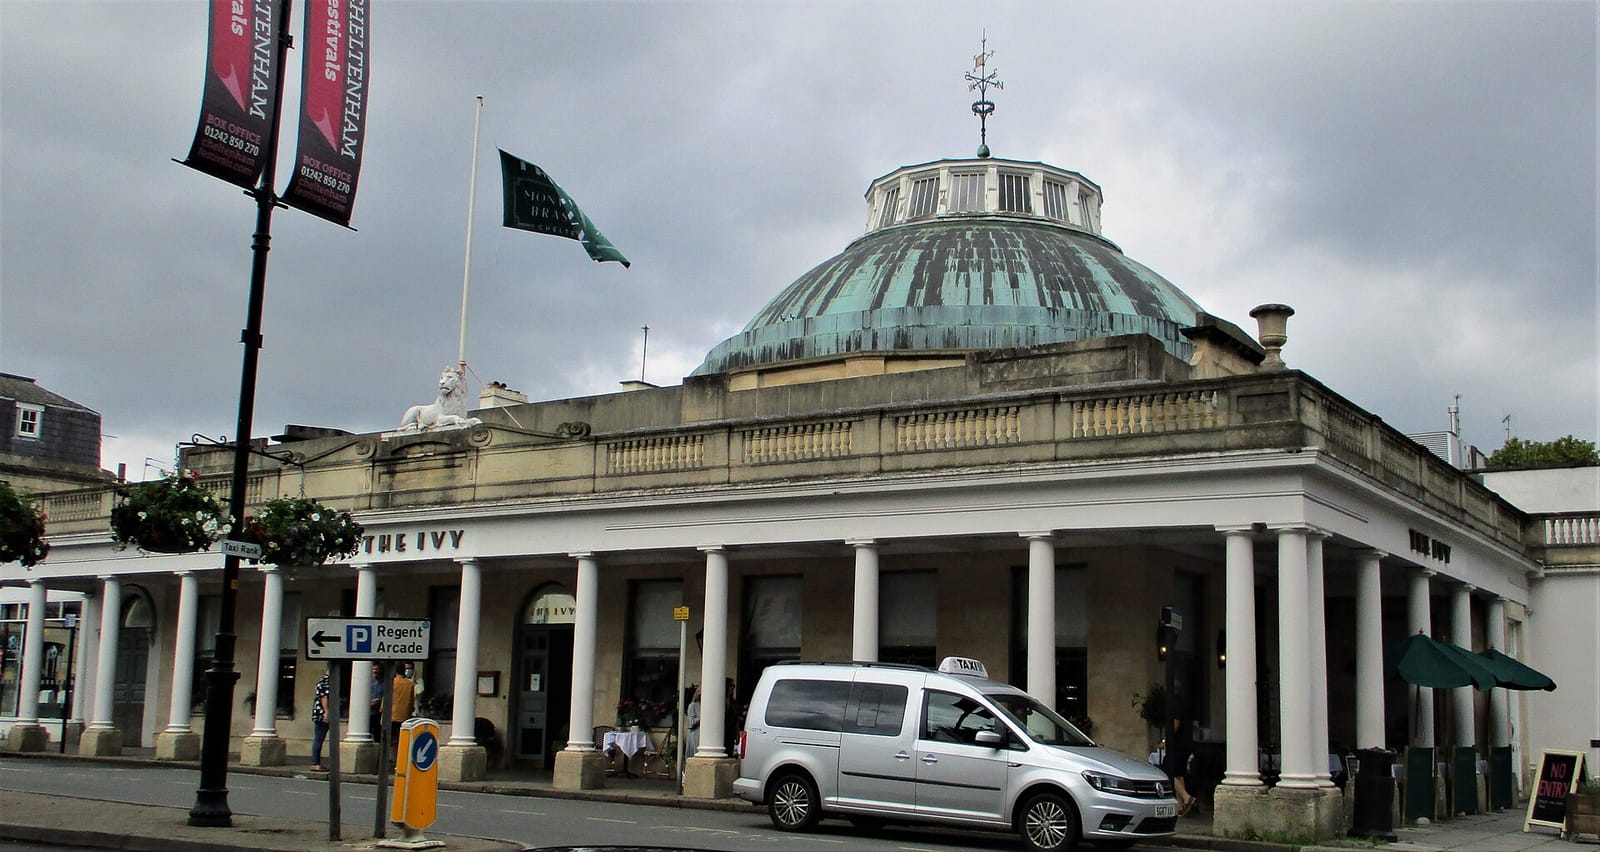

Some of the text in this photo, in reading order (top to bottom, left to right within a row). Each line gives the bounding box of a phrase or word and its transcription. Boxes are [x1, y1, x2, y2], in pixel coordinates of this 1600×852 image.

[207, 114, 261, 145] BOX OFFICE
[205, 125, 259, 156] 01242 850 270
[303, 155, 352, 183] BOX OFFICE
[301, 166, 350, 194] 01242 850 270
[224, 543, 259, 555] Taxi Rank
[363, 529, 464, 554] THE IVY
[554, 607, 575, 616] IVY
[352, 628, 369, 651] P
[377, 625, 424, 640] Regent
[377, 641, 423, 653] Arcade
[957, 658, 978, 671] TAXI
[1550, 762, 1567, 779] NO
[1538, 780, 1570, 799] ENTRY
